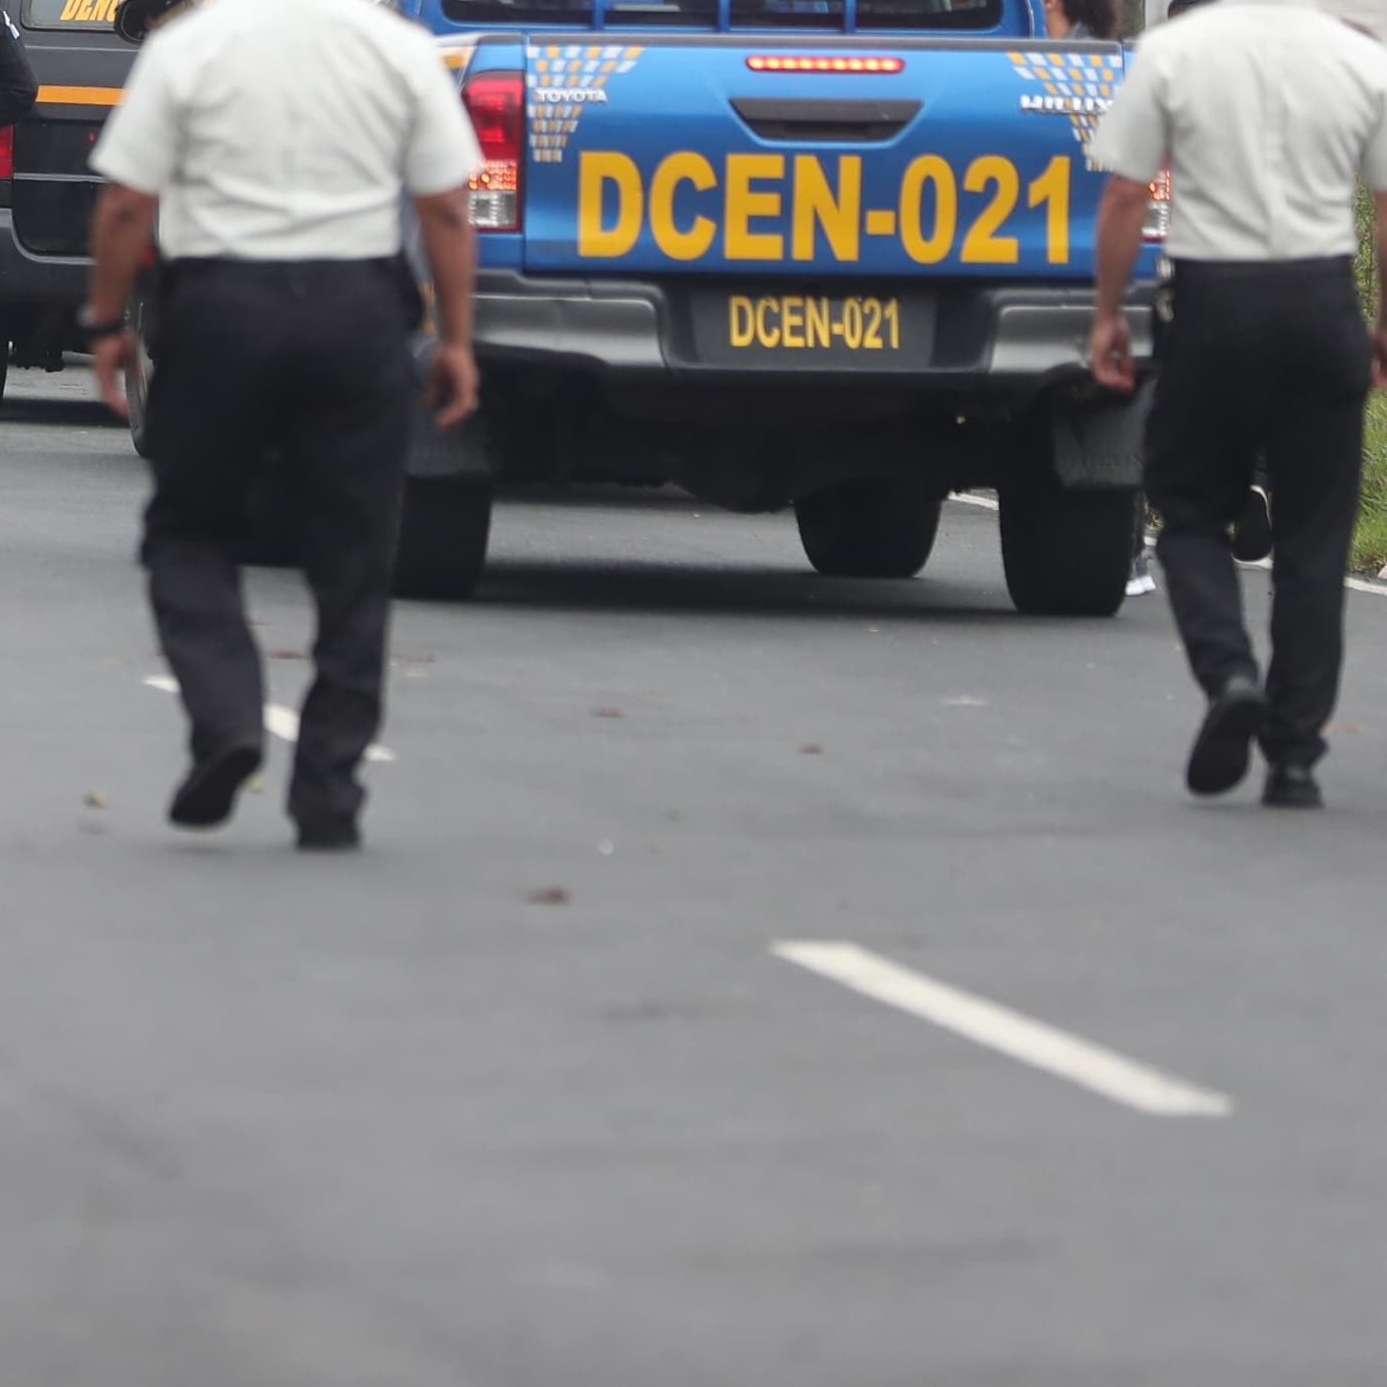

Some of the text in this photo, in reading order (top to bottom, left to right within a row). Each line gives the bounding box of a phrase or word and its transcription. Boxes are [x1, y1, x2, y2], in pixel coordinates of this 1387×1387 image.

[535, 86, 608, 103] TOYOTA
[577, 151, 1071, 264] DCEN-021
[729, 296, 900, 349] DCEN-021
